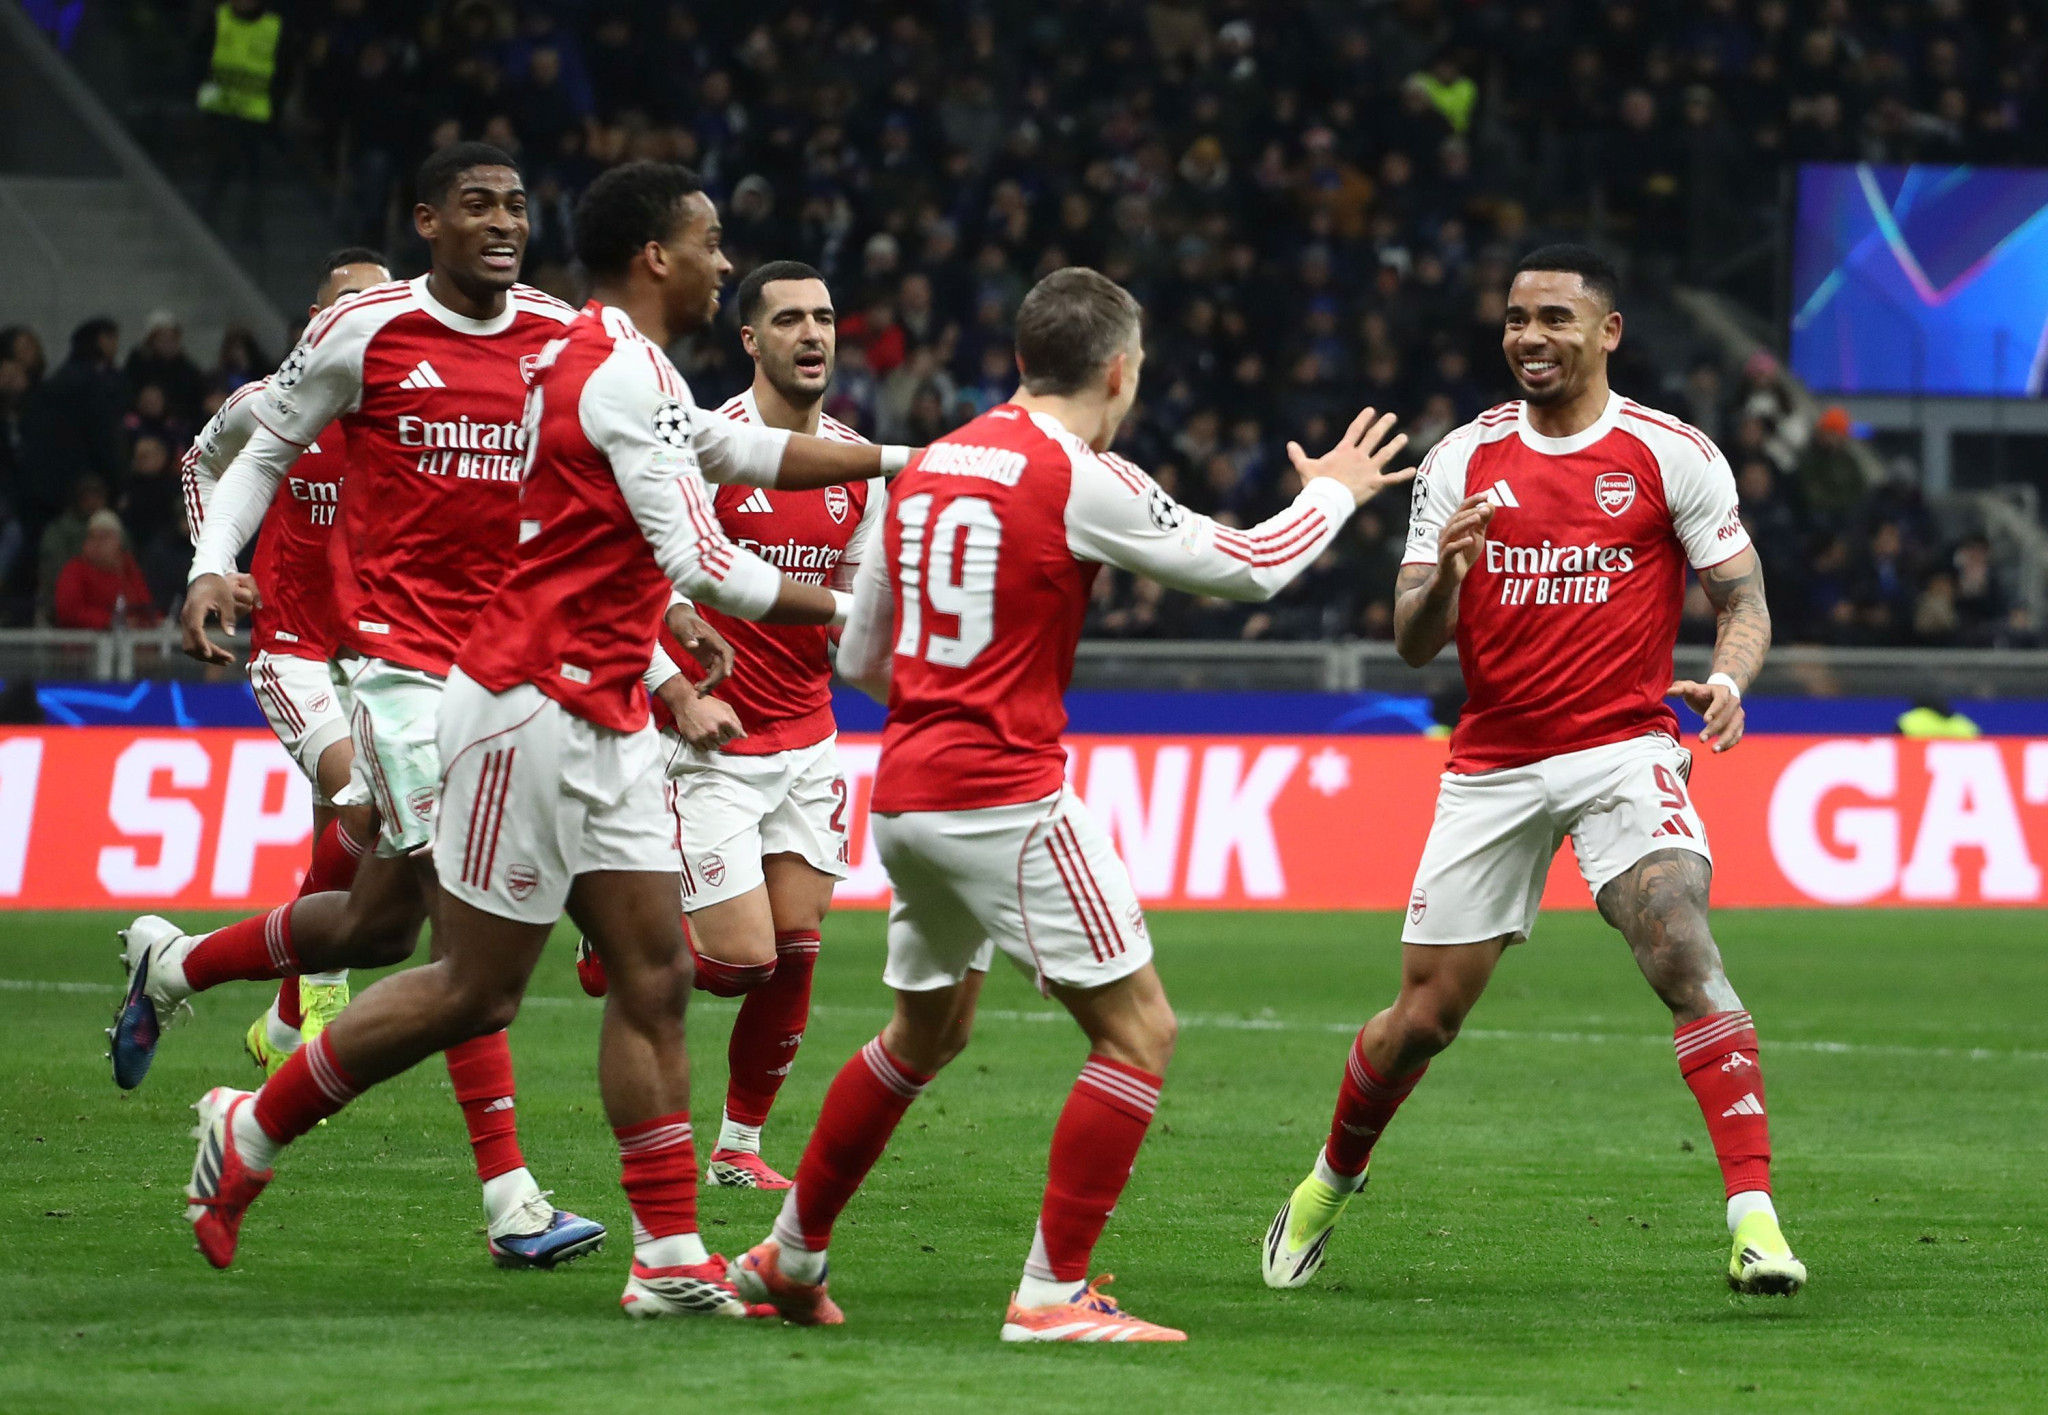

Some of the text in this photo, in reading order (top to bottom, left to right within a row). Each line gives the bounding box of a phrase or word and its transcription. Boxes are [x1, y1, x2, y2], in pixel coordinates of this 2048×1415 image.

[398, 414, 526, 451] Emirate
[416, 451, 524, 482] FLY BETTER
[917, 441, 1028, 487] TROSSARD
[288, 476, 345, 502] Em
[1601, 480, 1630, 488] Arsenal
[311, 504, 336, 526] FLY
[737, 537, 843, 569] Emirate
[1485, 539, 1634, 575] Emirates
[895, 493, 1003, 668] 19
[1500, 576, 1610, 606] FLY BETTER
[1652, 763, 1687, 810] 9
[830, 778, 847, 833] 2
[1767, 739, 2048, 905] GA
